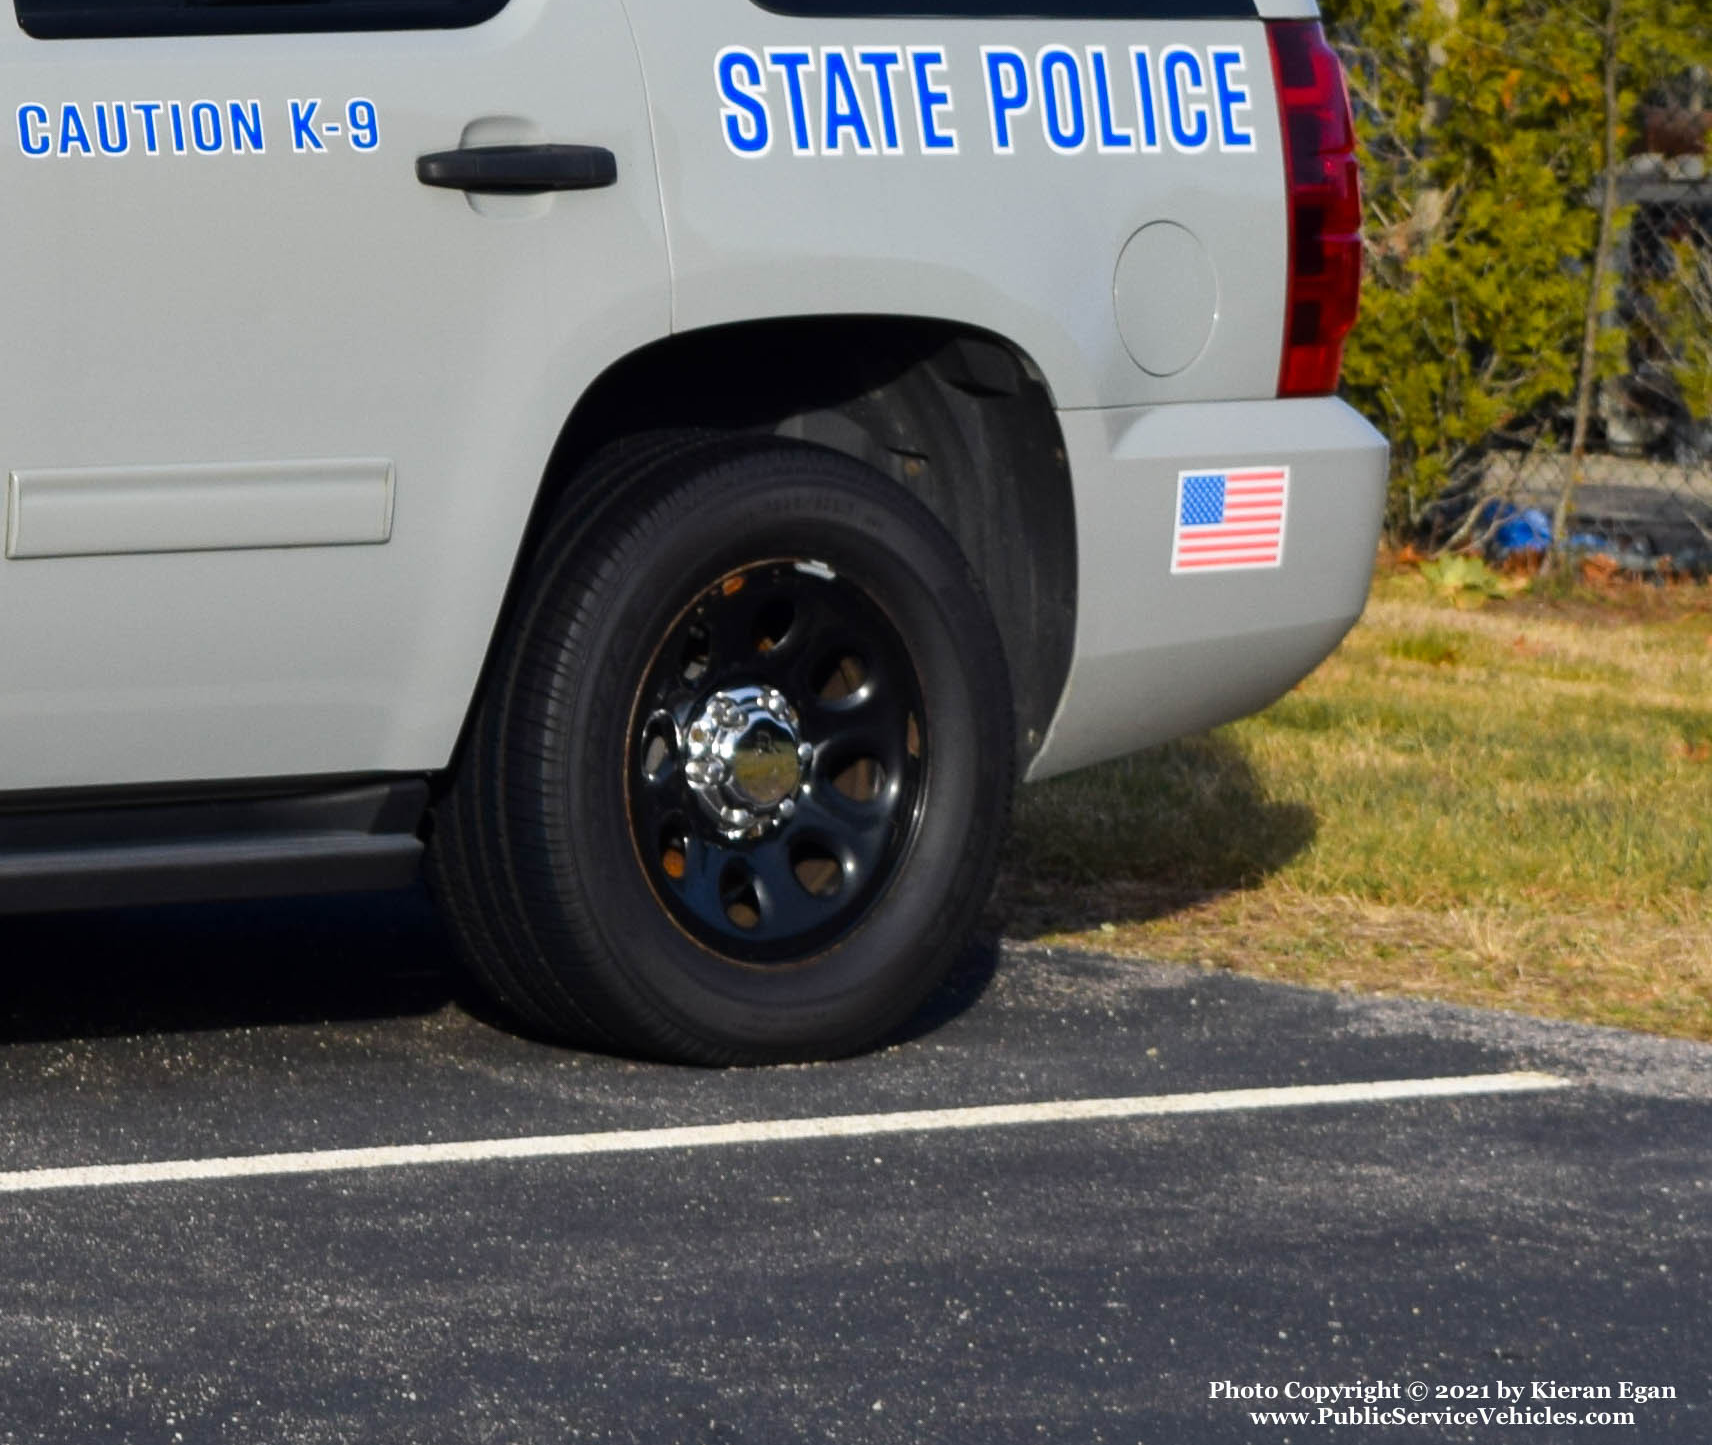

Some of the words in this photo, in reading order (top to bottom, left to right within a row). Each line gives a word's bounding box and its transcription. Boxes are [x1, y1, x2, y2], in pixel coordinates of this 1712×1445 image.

[15, 100, 265, 157] CAUTION
[288, 97, 381, 151] K-9
[714, 45, 959, 156] STATE
[980, 44, 1256, 154] POLICE
